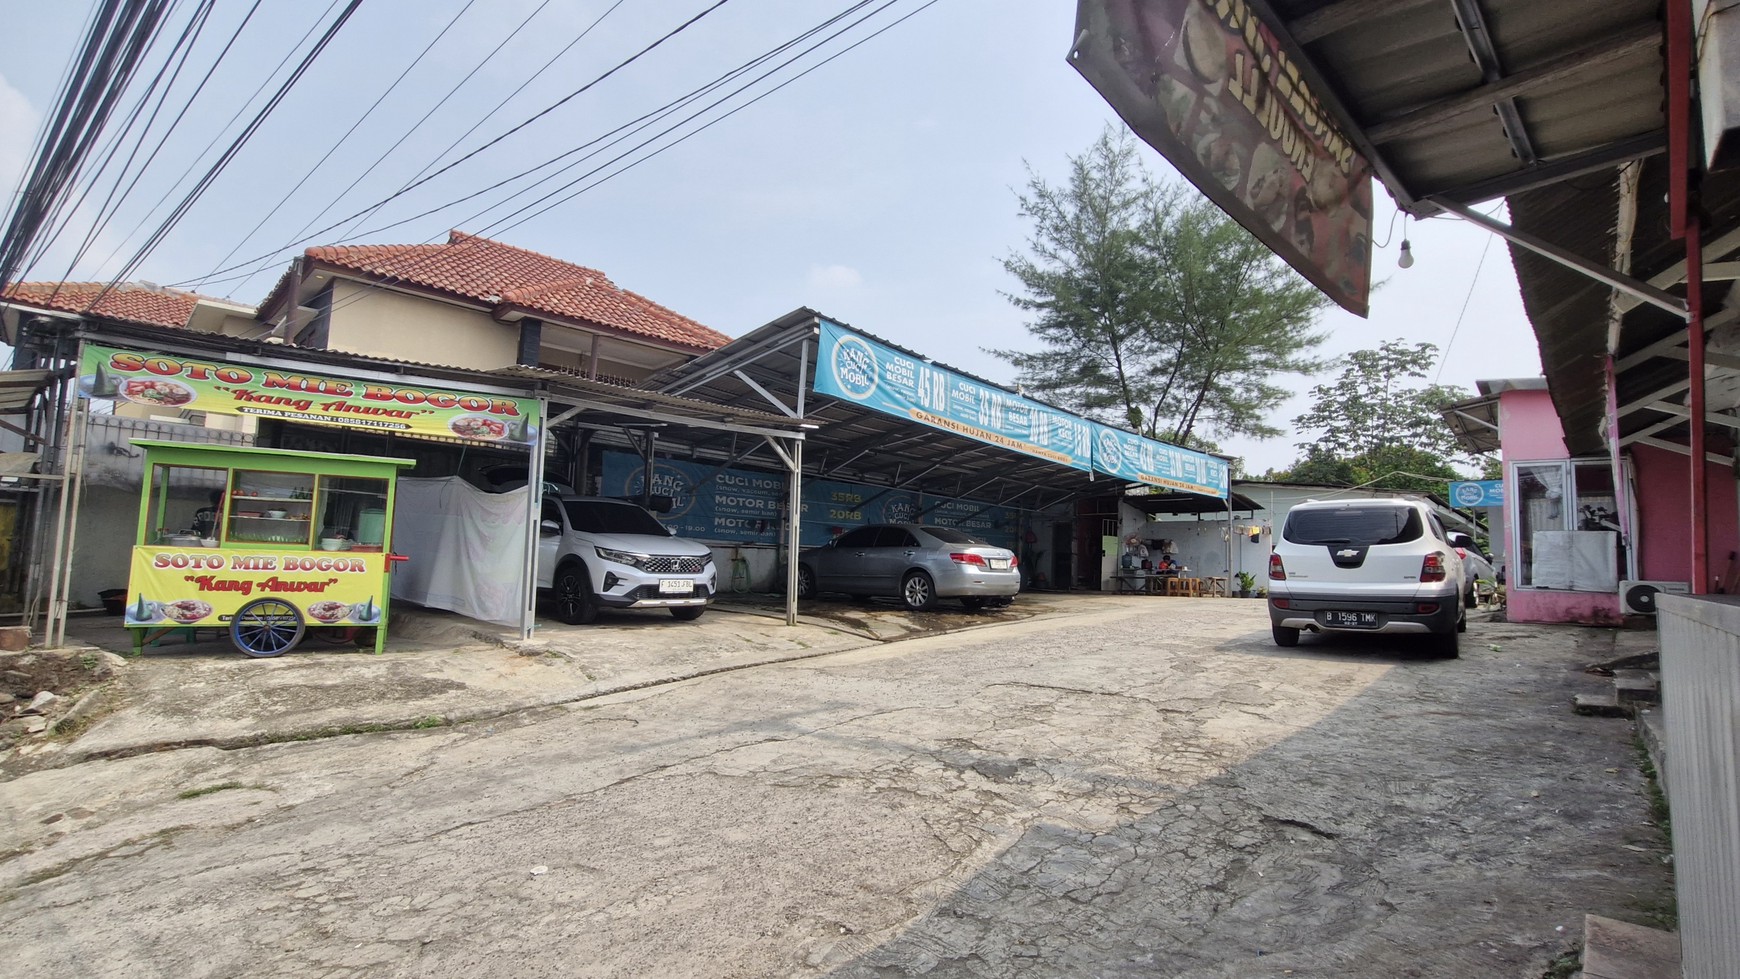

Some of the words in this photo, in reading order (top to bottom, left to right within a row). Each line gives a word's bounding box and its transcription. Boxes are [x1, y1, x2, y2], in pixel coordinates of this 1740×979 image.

[886, 361, 915, 378] MOBIL
[894, 356, 915, 370] CUCI
[110, 352, 252, 384] SOTO
[262, 371, 354, 397] MIE
[361, 383, 521, 416] BOGOR
[840, 367, 870, 387] MOBIL
[886, 371, 915, 388] BESAR
[918, 366, 930, 408] 45
[933, 371, 945, 412] RB
[958, 382, 976, 395] CUCI
[952, 389, 976, 405] MOBIL
[1006, 399, 1028, 414] MOTOR
[242, 408, 282, 416] TERIMA
[285, 412, 331, 422] PESANAN
[1008, 412, 1028, 426] BESAR
[916, 412, 959, 431] GARANSI
[962, 425, 992, 440] HUJAN
[995, 436, 1004, 445] 24
[715, 474, 748, 486] CUCI
[714, 495, 764, 509] MOTOR
[831, 492, 862, 503] 35RB
[830, 508, 862, 520] 20RB
[154, 553, 225, 570] SOTO
[230, 554, 278, 571] MIE
[282, 555, 366, 573] BOGOR
[1326, 612, 1332, 620] B
[1338, 612, 1358, 622] 1596
[1361, 613, 1376, 622] TMK
